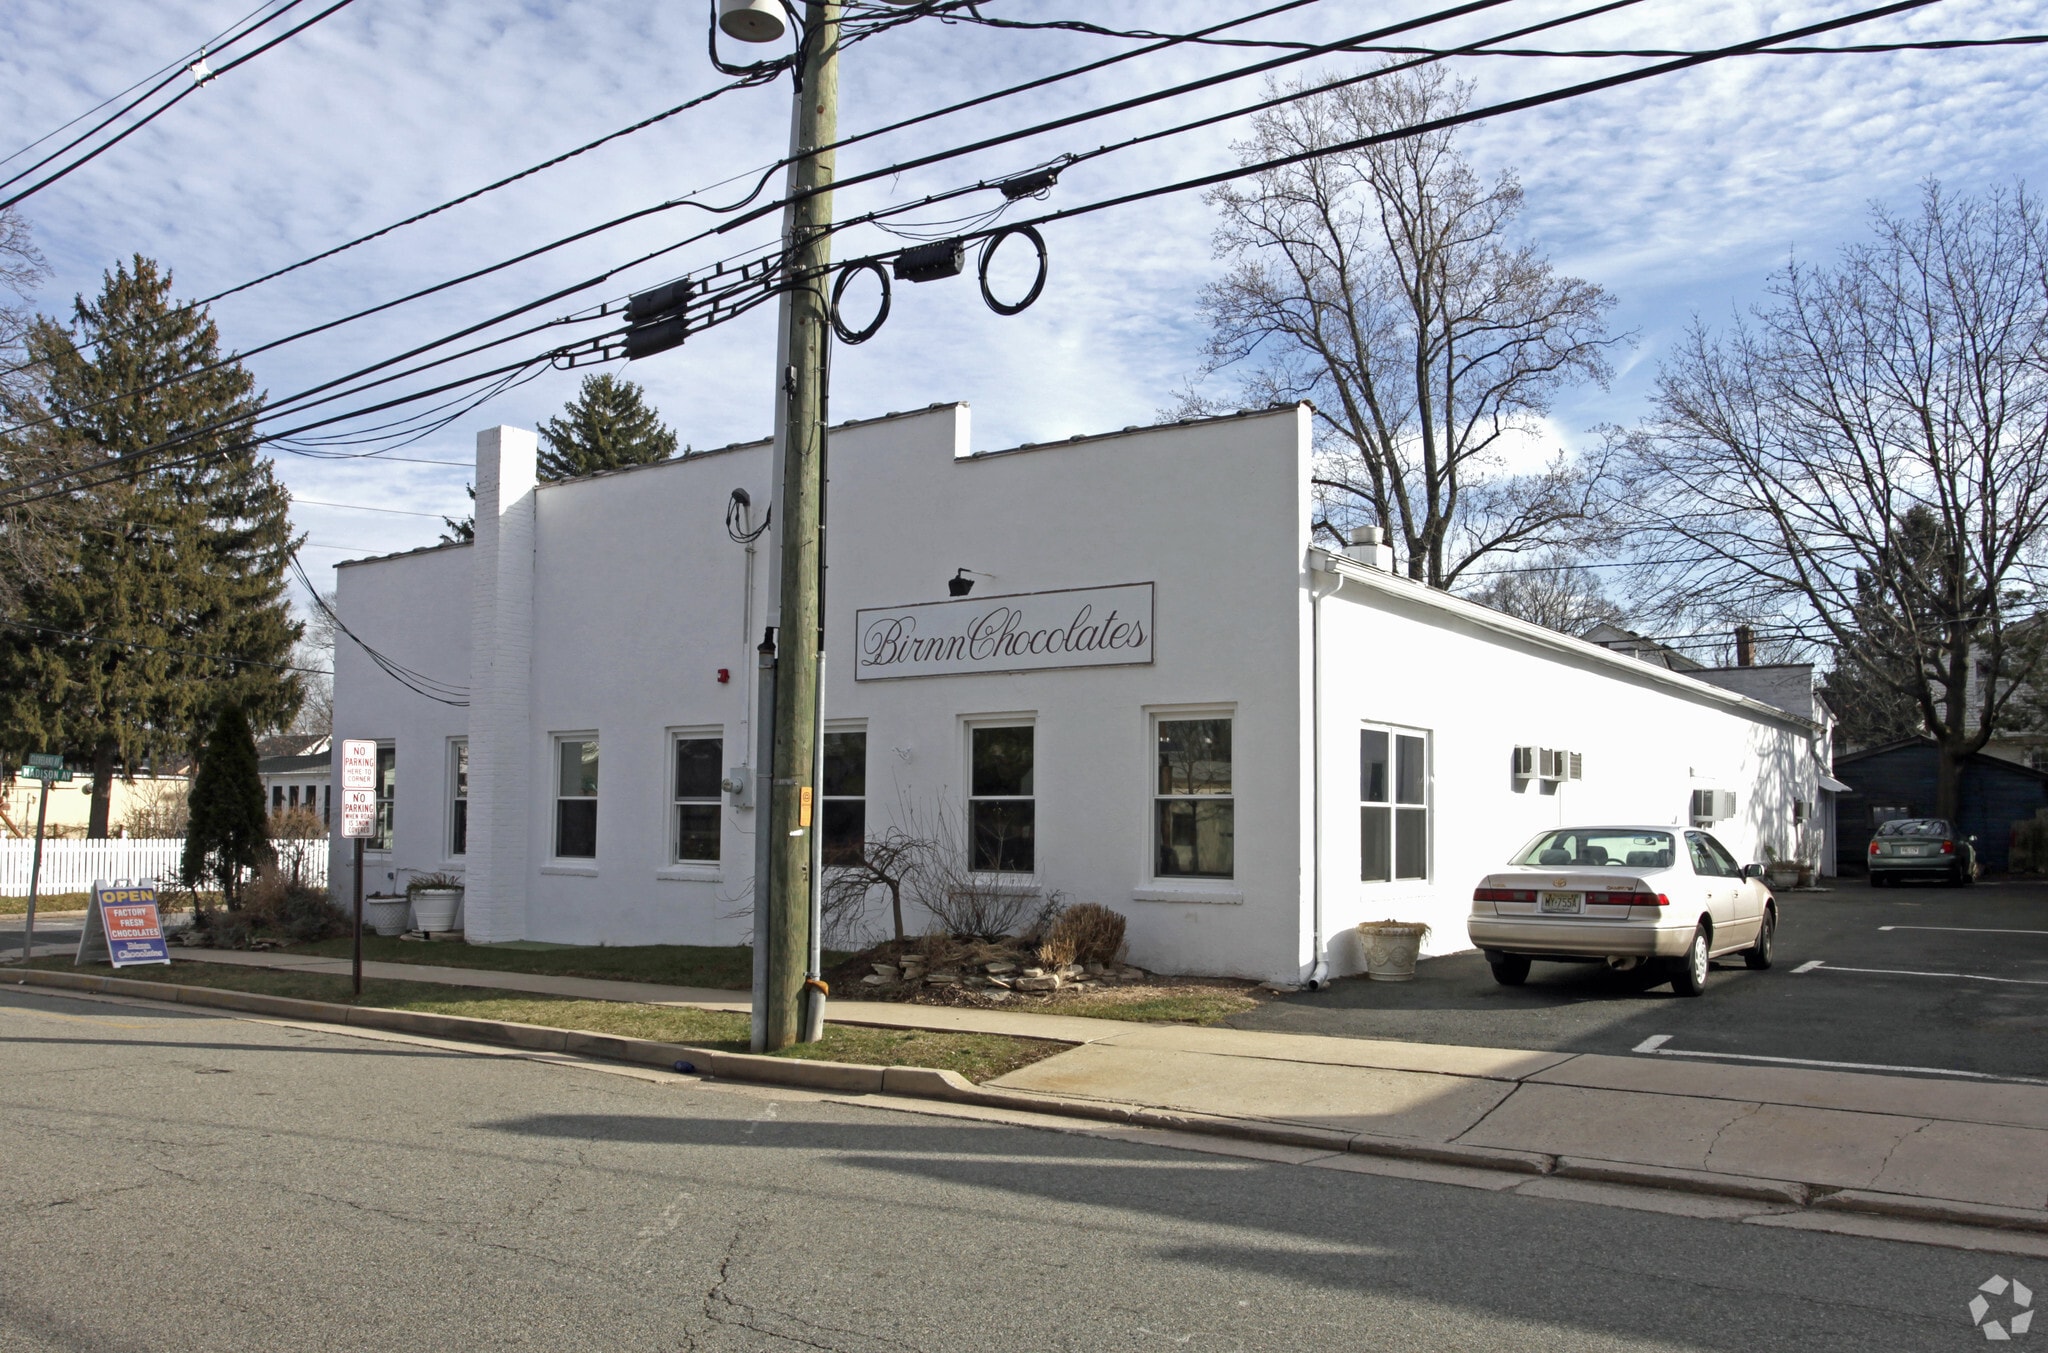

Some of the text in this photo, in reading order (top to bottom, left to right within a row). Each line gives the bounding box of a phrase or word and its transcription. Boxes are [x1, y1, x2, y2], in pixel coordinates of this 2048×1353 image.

[861, 604, 1148, 666] Birnn Chocolates
[353, 747, 366, 756] NO
[345, 757, 374, 767] PARKING
[23, 767, 59, 779] MADISON
[353, 793, 366, 803] NO
[345, 804, 374, 813] PARKING
[102, 890, 154, 903] OPEN
[113, 907, 146, 917] FACTORY
[120, 919, 145, 927] FRESH
[111, 928, 159, 937] CHOCOLATES
